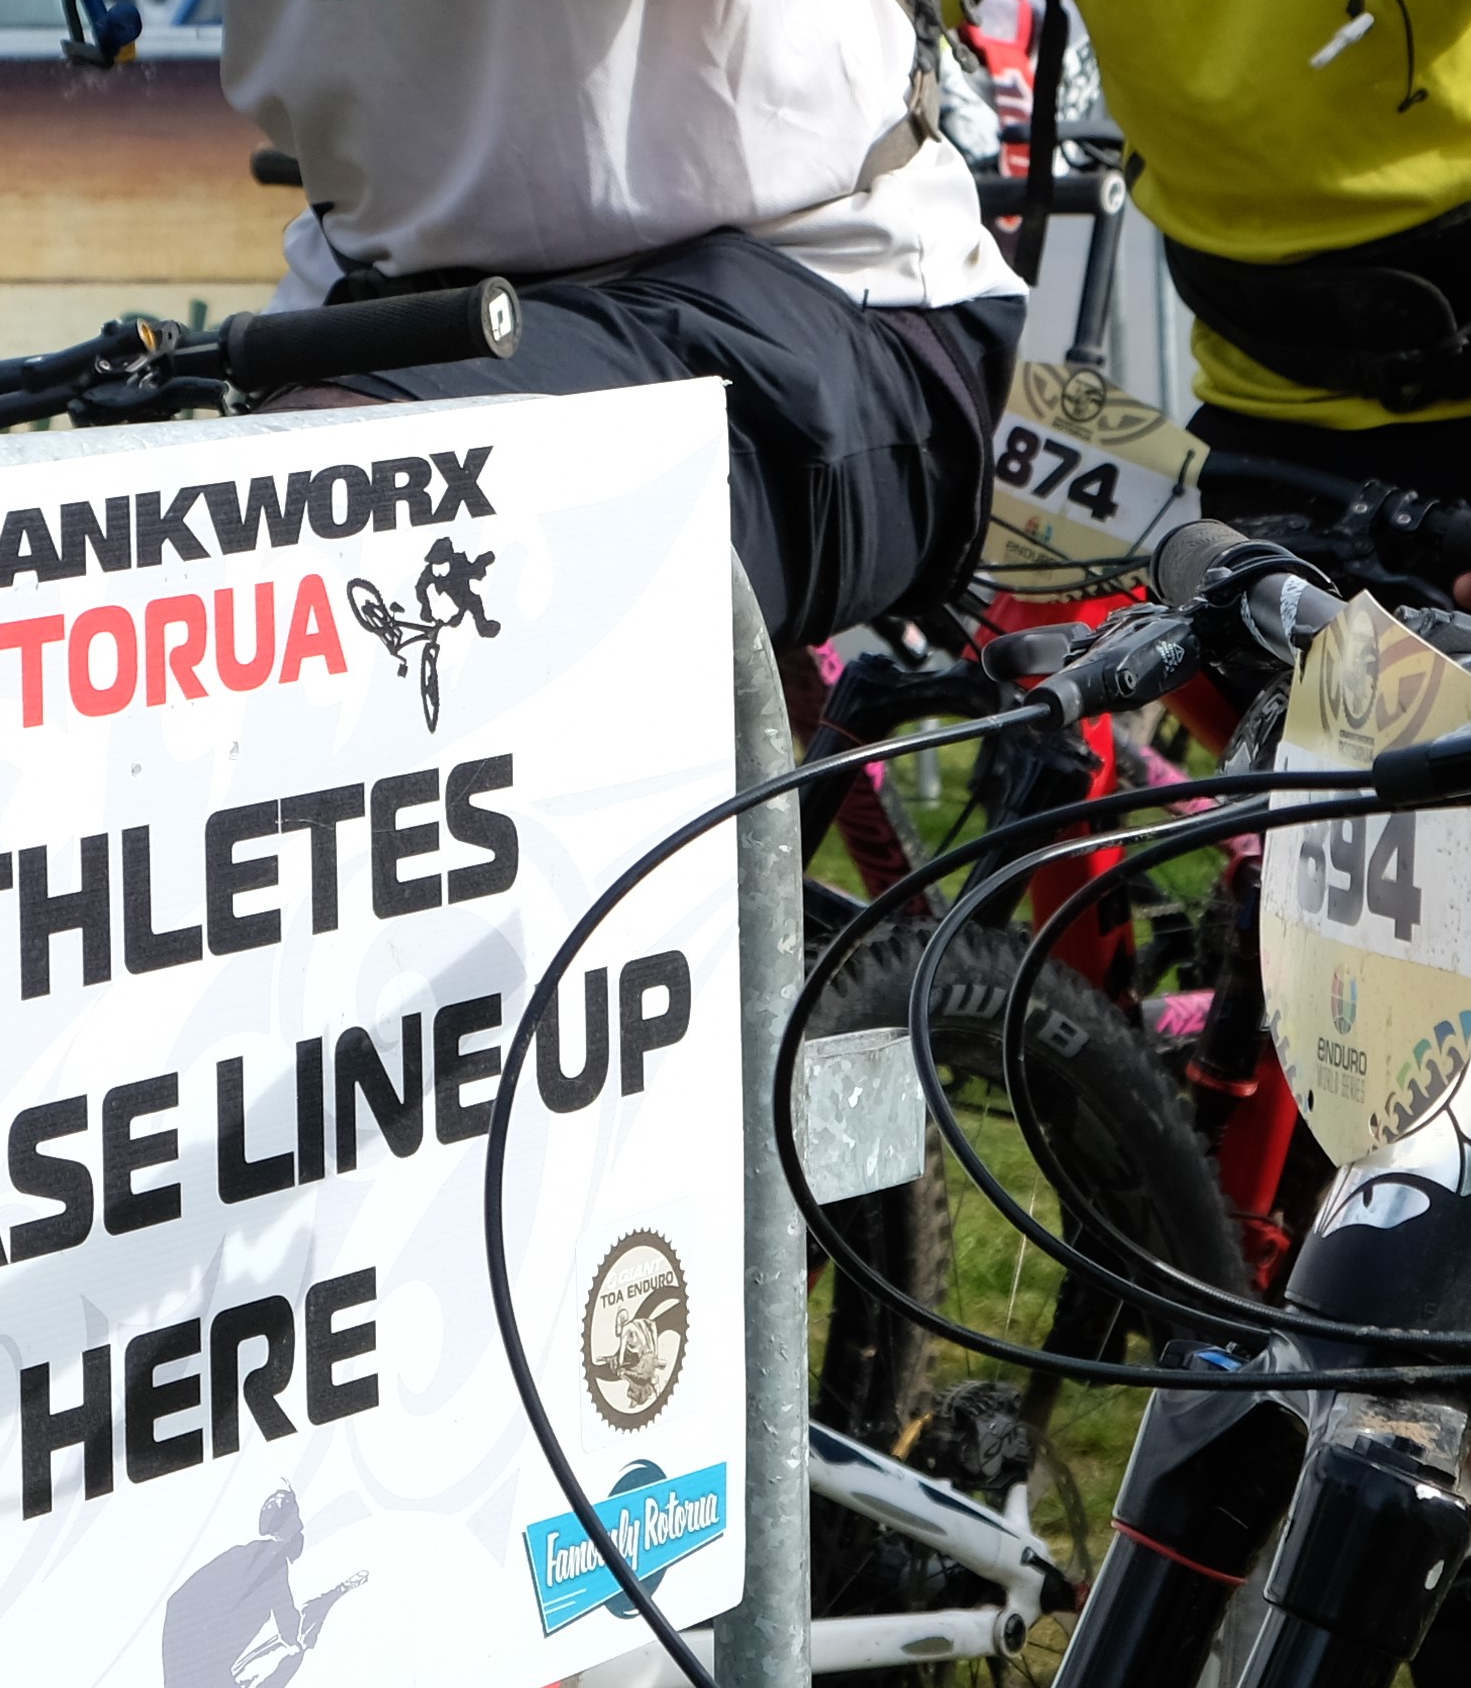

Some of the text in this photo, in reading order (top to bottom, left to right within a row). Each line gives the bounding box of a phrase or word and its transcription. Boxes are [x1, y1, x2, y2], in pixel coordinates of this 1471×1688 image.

[996, 425, 1120, 523] 874
[1297, 790, 1423, 943] 894
[928, 982, 1090, 1058] WB
[217, 992, 503, 1205] LINE
[535, 950, 693, 1115] UP
[600, 1271, 674, 1309] TOA ENDURO
[617, 1257, 663, 1285] GIANT
[19, 1266, 379, 1520] HERE
[545, 1490, 720, 1588] Famoly Rotorua
